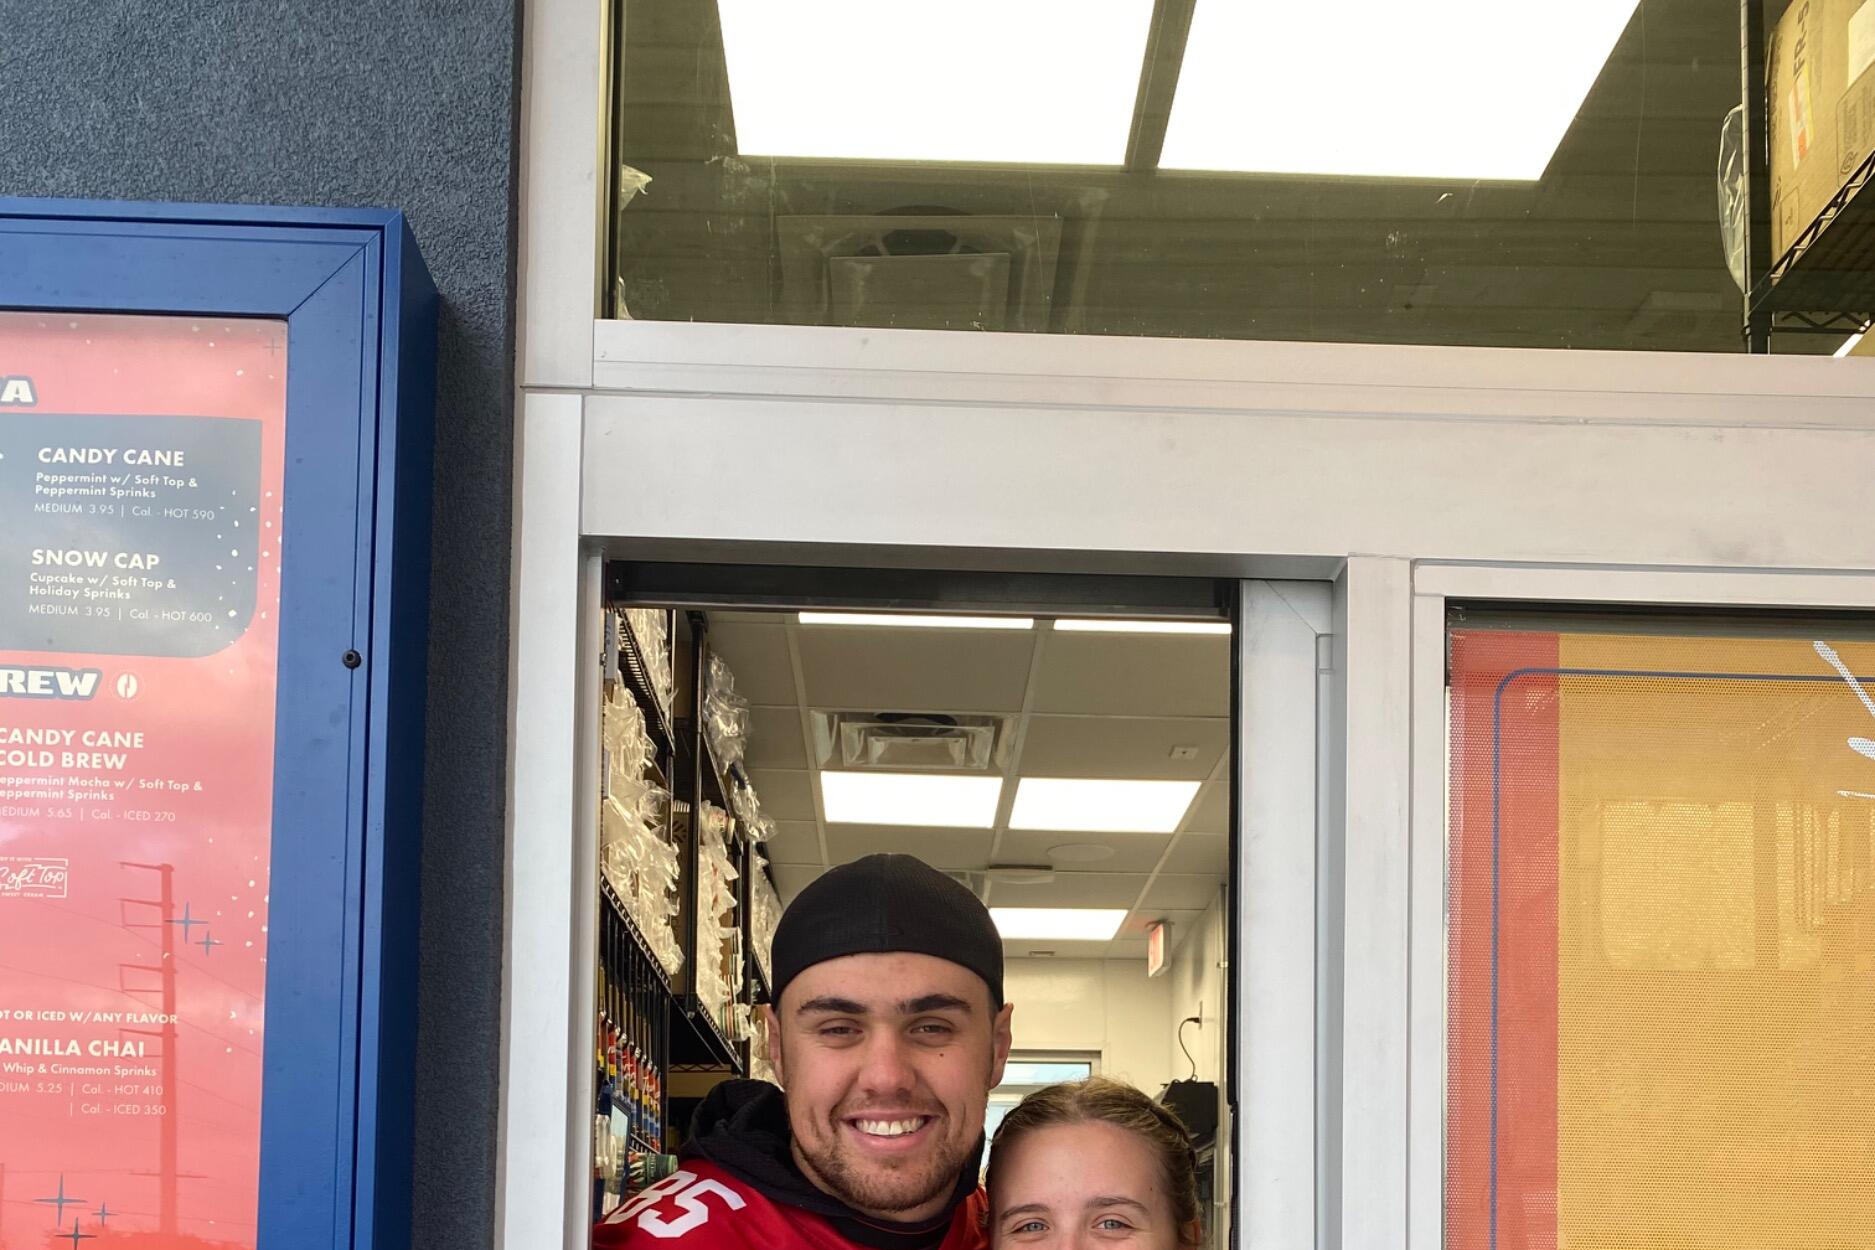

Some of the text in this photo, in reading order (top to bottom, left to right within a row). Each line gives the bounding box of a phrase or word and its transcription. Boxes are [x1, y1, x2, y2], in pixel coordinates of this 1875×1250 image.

[1, 380, 33, 402] A
[38, 447, 185, 467] CANDY CANE
[36, 472, 198, 489] Peppermint w/ Soft Top &
[35, 485, 156, 499] Peppermint Sprinks
[34, 503, 83, 513] MEDIUM
[165, 507, 188, 519] HOT
[192, 509, 215, 521] 590
[32, 549, 160, 570] SNOW CAP
[30, 572, 176, 591] Cupcake w/ Soft Top &
[29, 585, 131, 601] Holiday Sprinks
[29, 604, 79, 615] MEDIUM
[162, 610, 186, 621] HOT
[189, 612, 213, 623] 600
[0, 669, 98, 696] REW
[0, 727, 144, 749] CANDY CANE
[61, 752, 128, 771] BREW
[68, 776, 110, 788] Mocha
[113, 778, 135, 790] w/
[139, 779, 164, 790] Soft
[168, 780, 189, 794] Top
[193, 781, 203, 791] &
[68, 790, 115, 802] Sprinks
[0, 806, 40, 817] EDIUM
[124, 810, 151, 821] ICED
[154, 811, 176, 822] 270
[13, 1010, 33, 1021] OR
[37, 1010, 66, 1021] ICED
[69, 1011, 122, 1024] W/ANY
[126, 1012, 178, 1024] FLAVOR
[0, 1038, 145, 1057] ANILLA CHAI
[2, 1062, 157, 1078] Whip & Cinnamon Sprinks
[114, 1084, 139, 1095] HOT
[143, 1085, 163, 1096] 410
[113, 1105, 140, 1115] ICED
[144, 1105, 167, 1116] 350
[604, 1170, 747, 1238] 85
